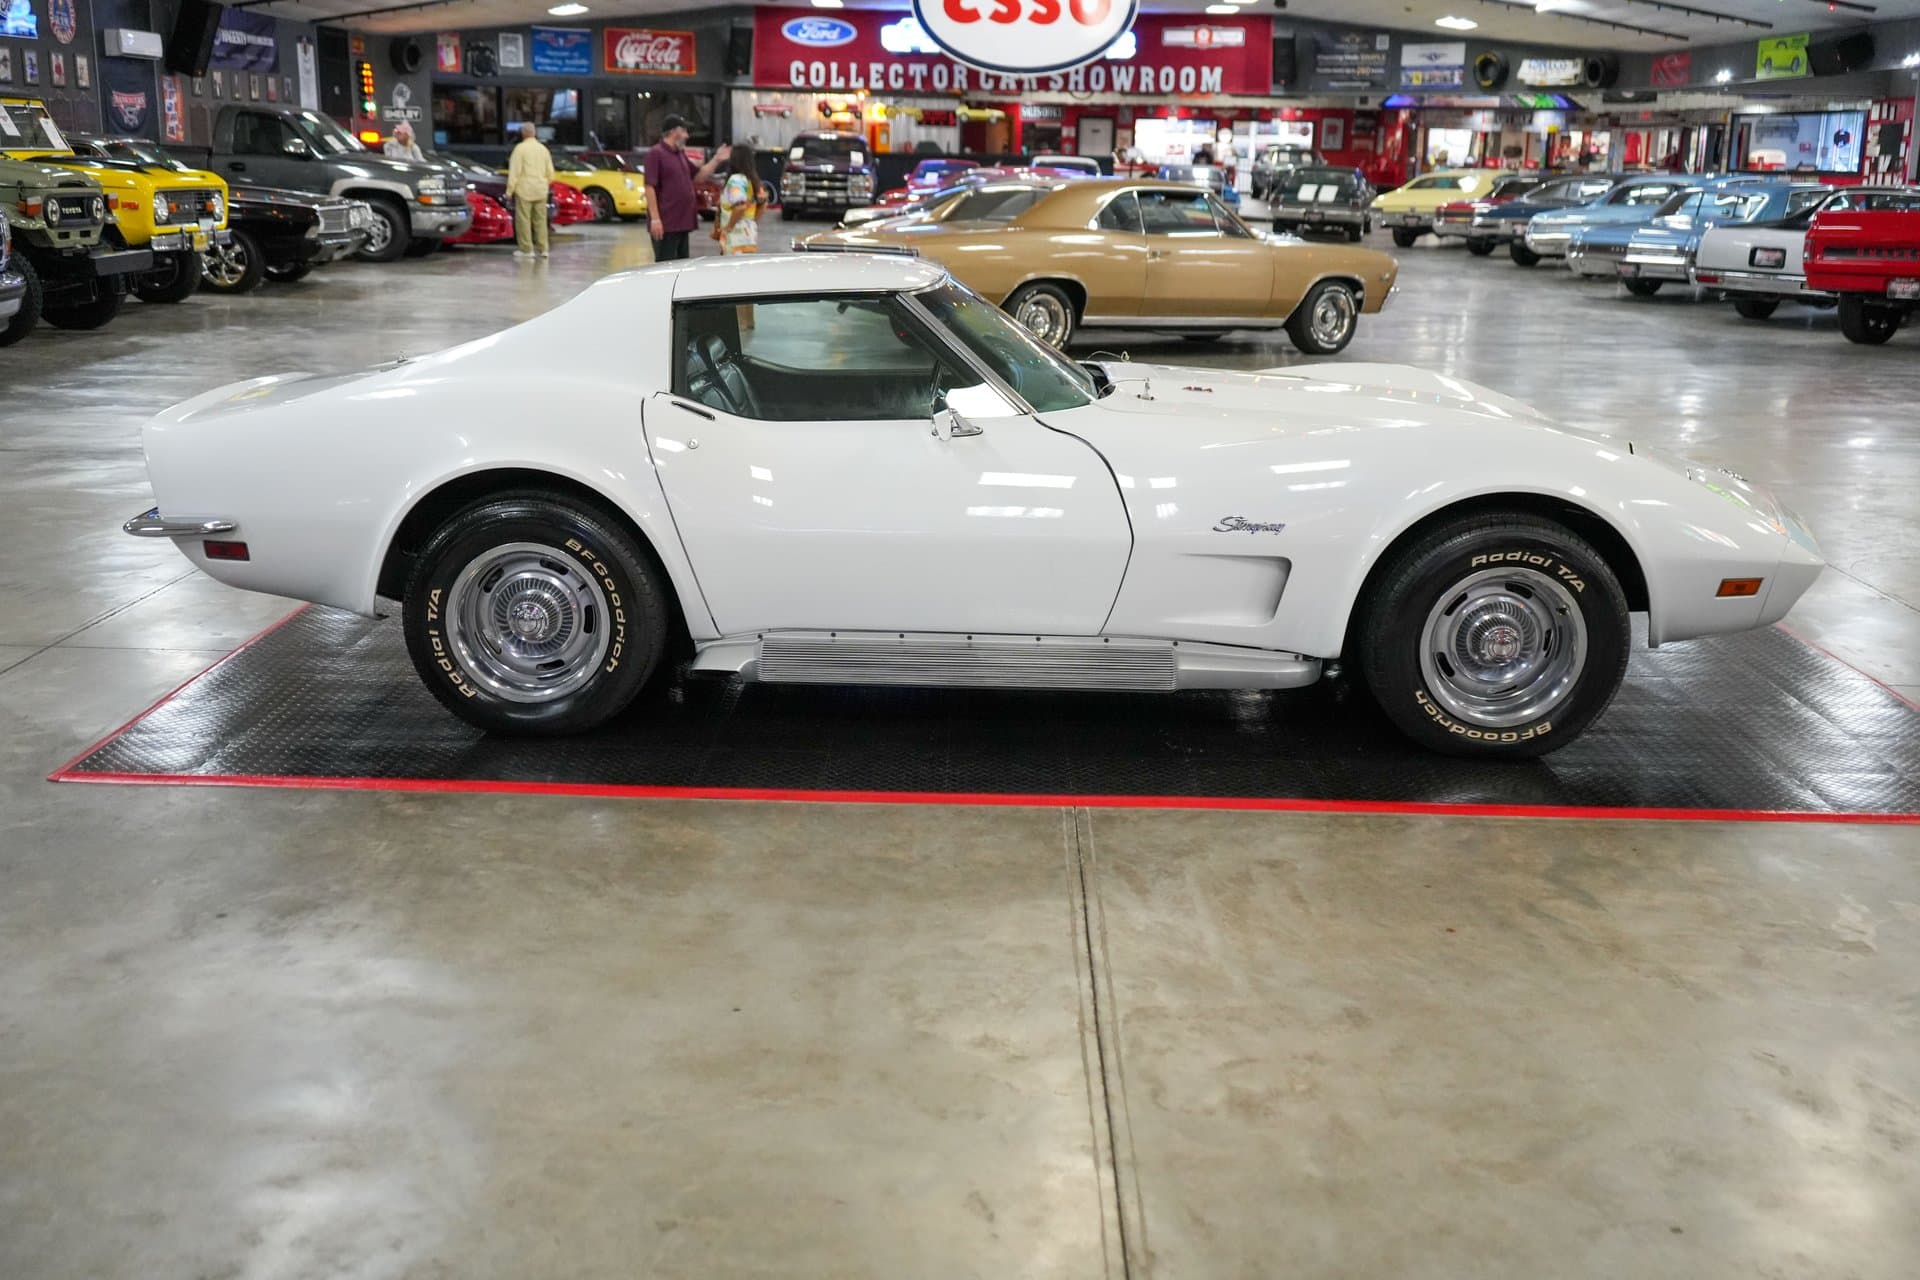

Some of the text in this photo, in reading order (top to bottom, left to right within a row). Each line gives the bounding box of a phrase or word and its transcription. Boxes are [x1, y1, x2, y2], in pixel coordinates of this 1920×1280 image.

[797, 20, 841, 41] Ford
[790, 60, 968, 91] COLLECTOR
[1050, 65, 1223, 94] SHOWROOM
[61, 206, 82, 215] TOYOTA
[1212, 516, 1286, 535] Stingray
[1471, 551, 1586, 593] Radial T/A
[565, 538, 627, 673] BFGoodrich
[427, 588, 478, 698] Radial T/A
[1415, 690, 1553, 742] BFGoodrich
